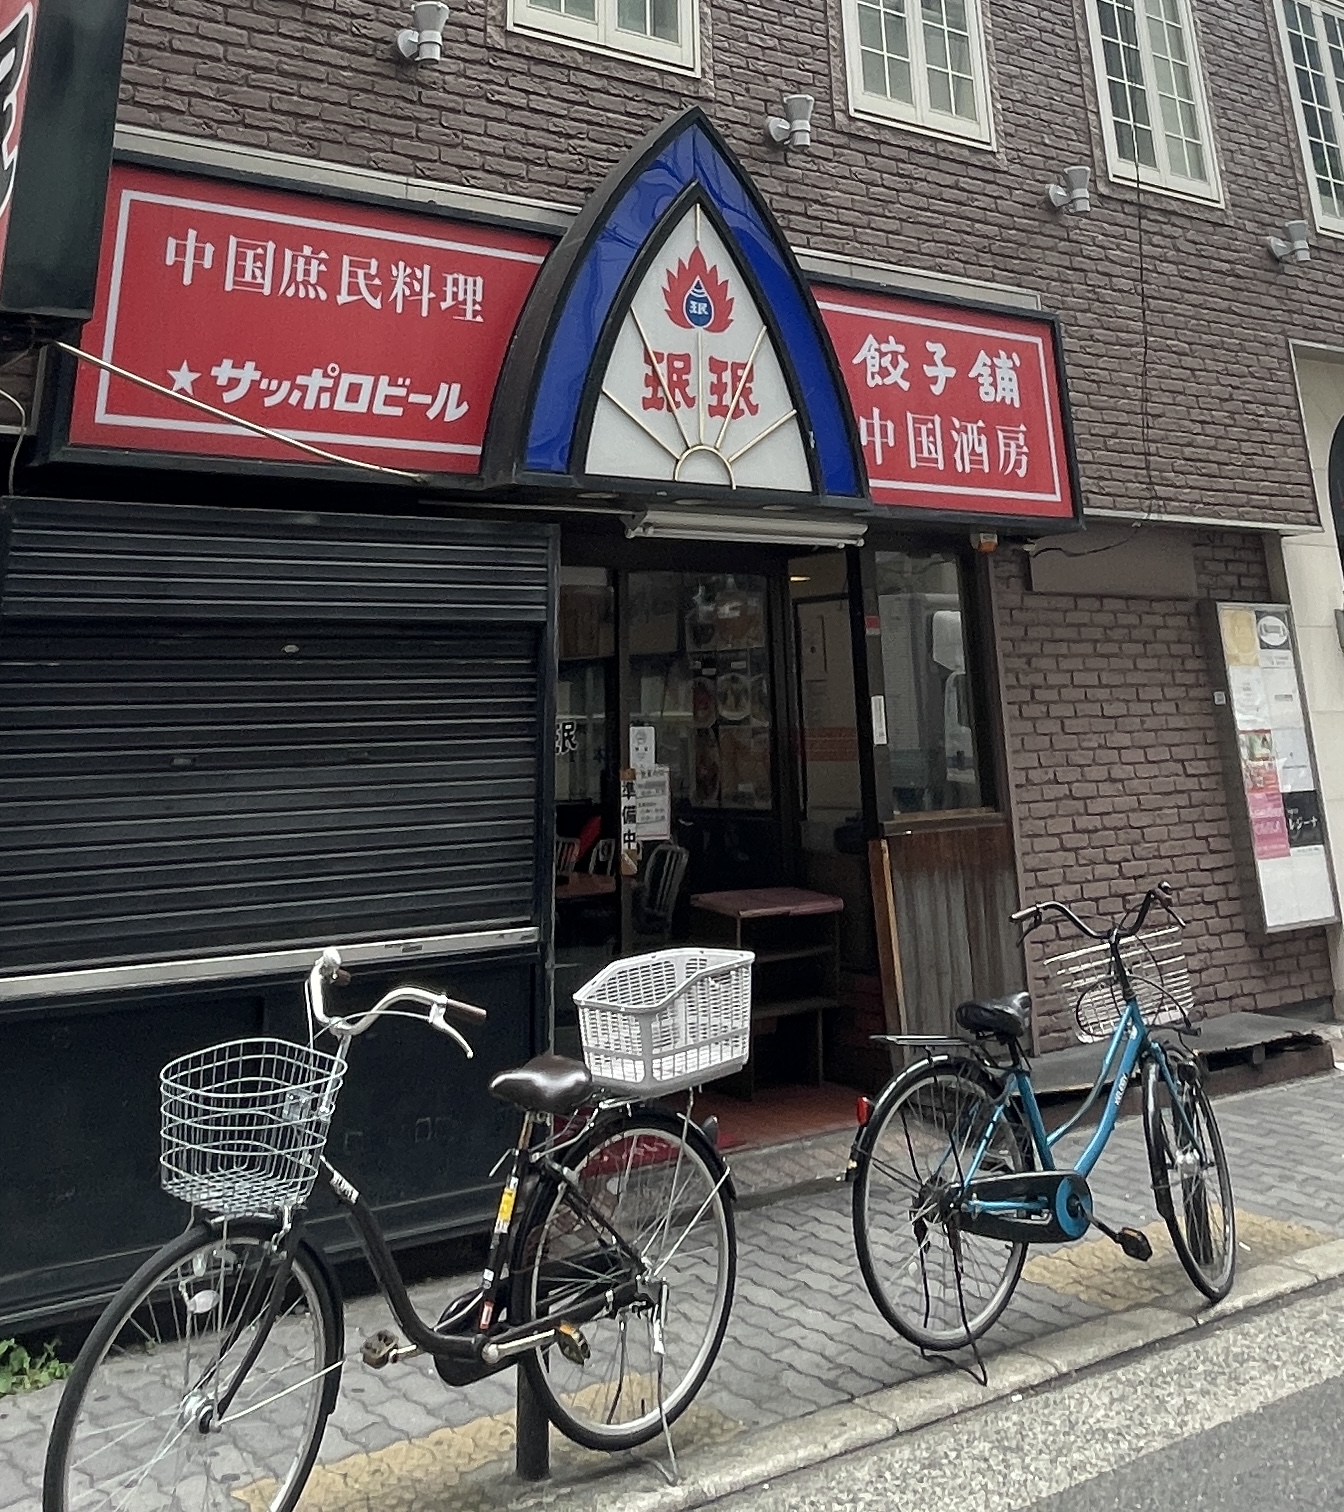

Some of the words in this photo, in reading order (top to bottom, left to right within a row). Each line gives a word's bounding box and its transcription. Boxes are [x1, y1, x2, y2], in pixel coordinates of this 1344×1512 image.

[164, 227, 485, 323] 中国庶民料理
[210, 357, 470, 423] サッポロビール
[641, 350, 760, 420] 珉珉
[858, 406, 1030, 478] 中国酒房
